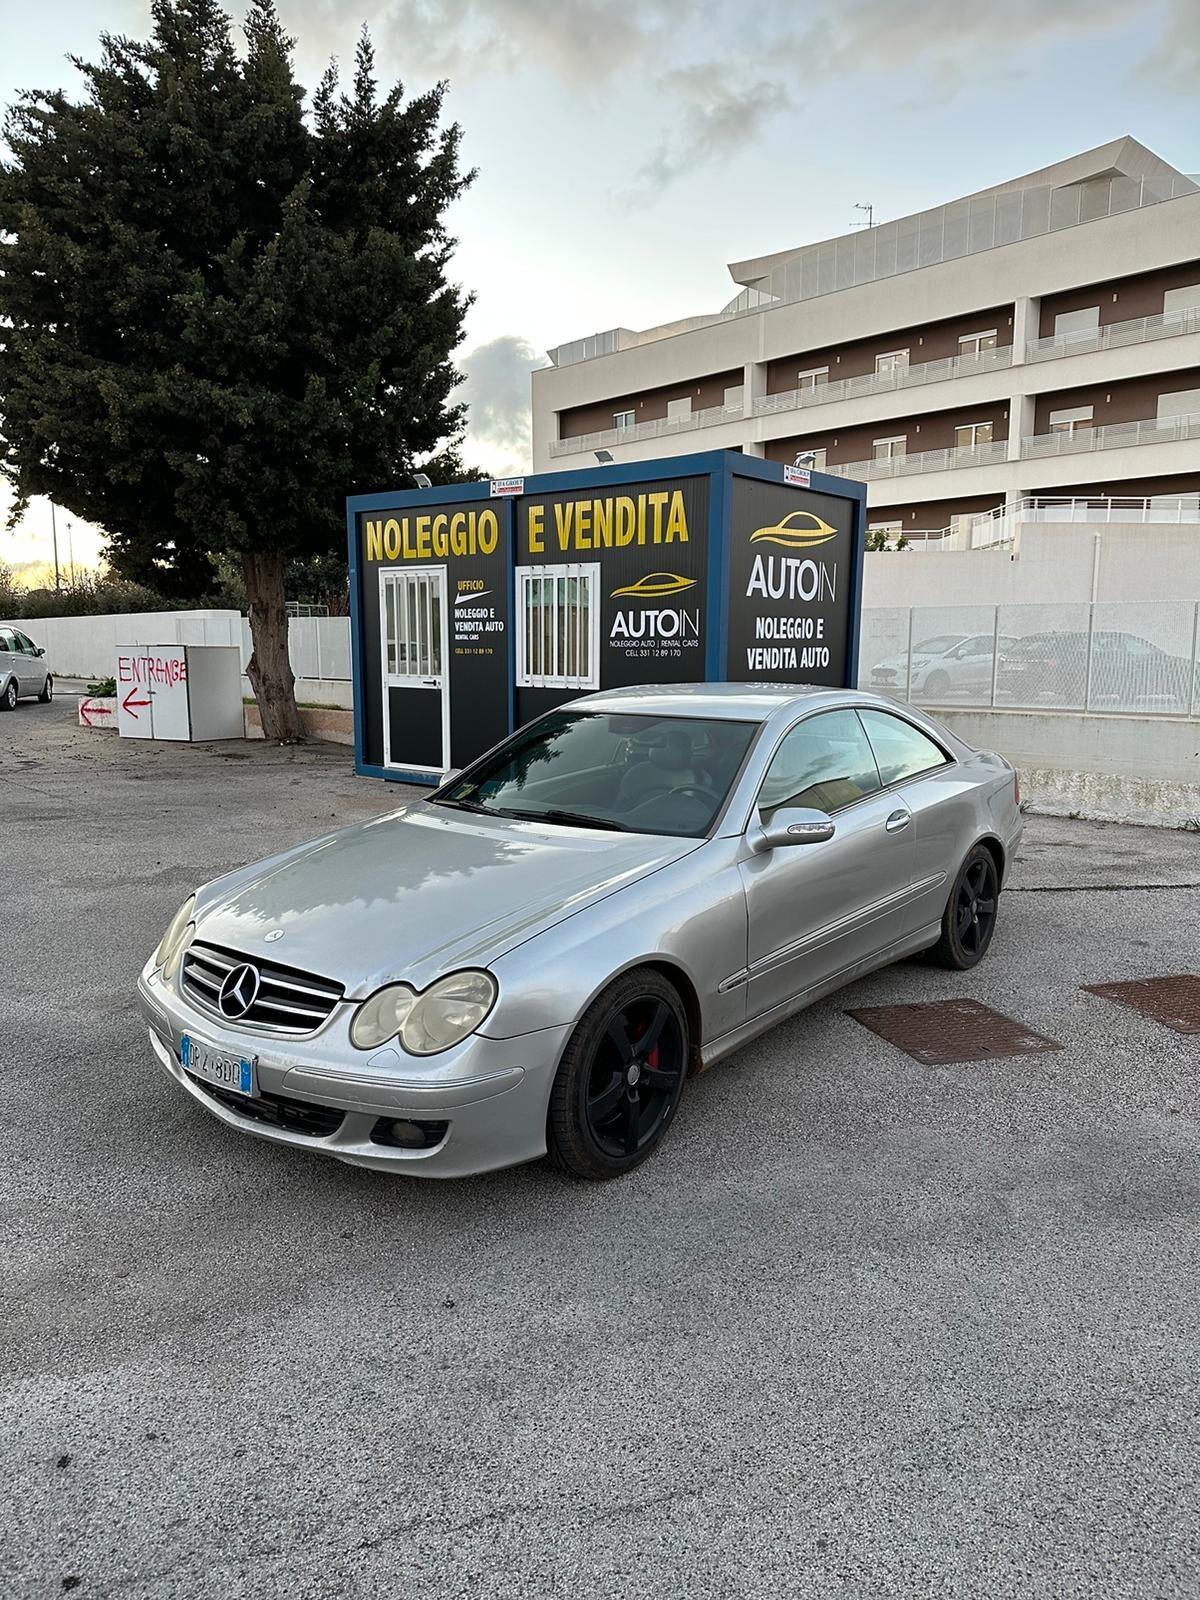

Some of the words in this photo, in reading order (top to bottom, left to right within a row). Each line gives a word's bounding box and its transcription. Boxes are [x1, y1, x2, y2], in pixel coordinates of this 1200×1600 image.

[366, 509, 498, 561] NOLEGGIO
[528, 505, 545, 553] E
[554, 490, 689, 551] VENDITA
[457, 580, 484, 591] UFFICIO
[746, 554, 837, 602] AUTOIN
[454, 608, 488, 619] NOLEGGIO
[489, 608, 495, 618] E
[609, 608, 699, 638] AUTOIN
[454, 621, 484, 632] VENDITA
[485, 621, 504, 632] AUTO
[755, 617, 814, 640] NOLEGGIO
[816, 618, 824, 639] E
[609, 640, 640, 648] NOLEGGIO
[682, 639, 699, 647] CARS
[746, 647, 797, 670] VENDITA
[800, 647, 830, 668] AUTO
